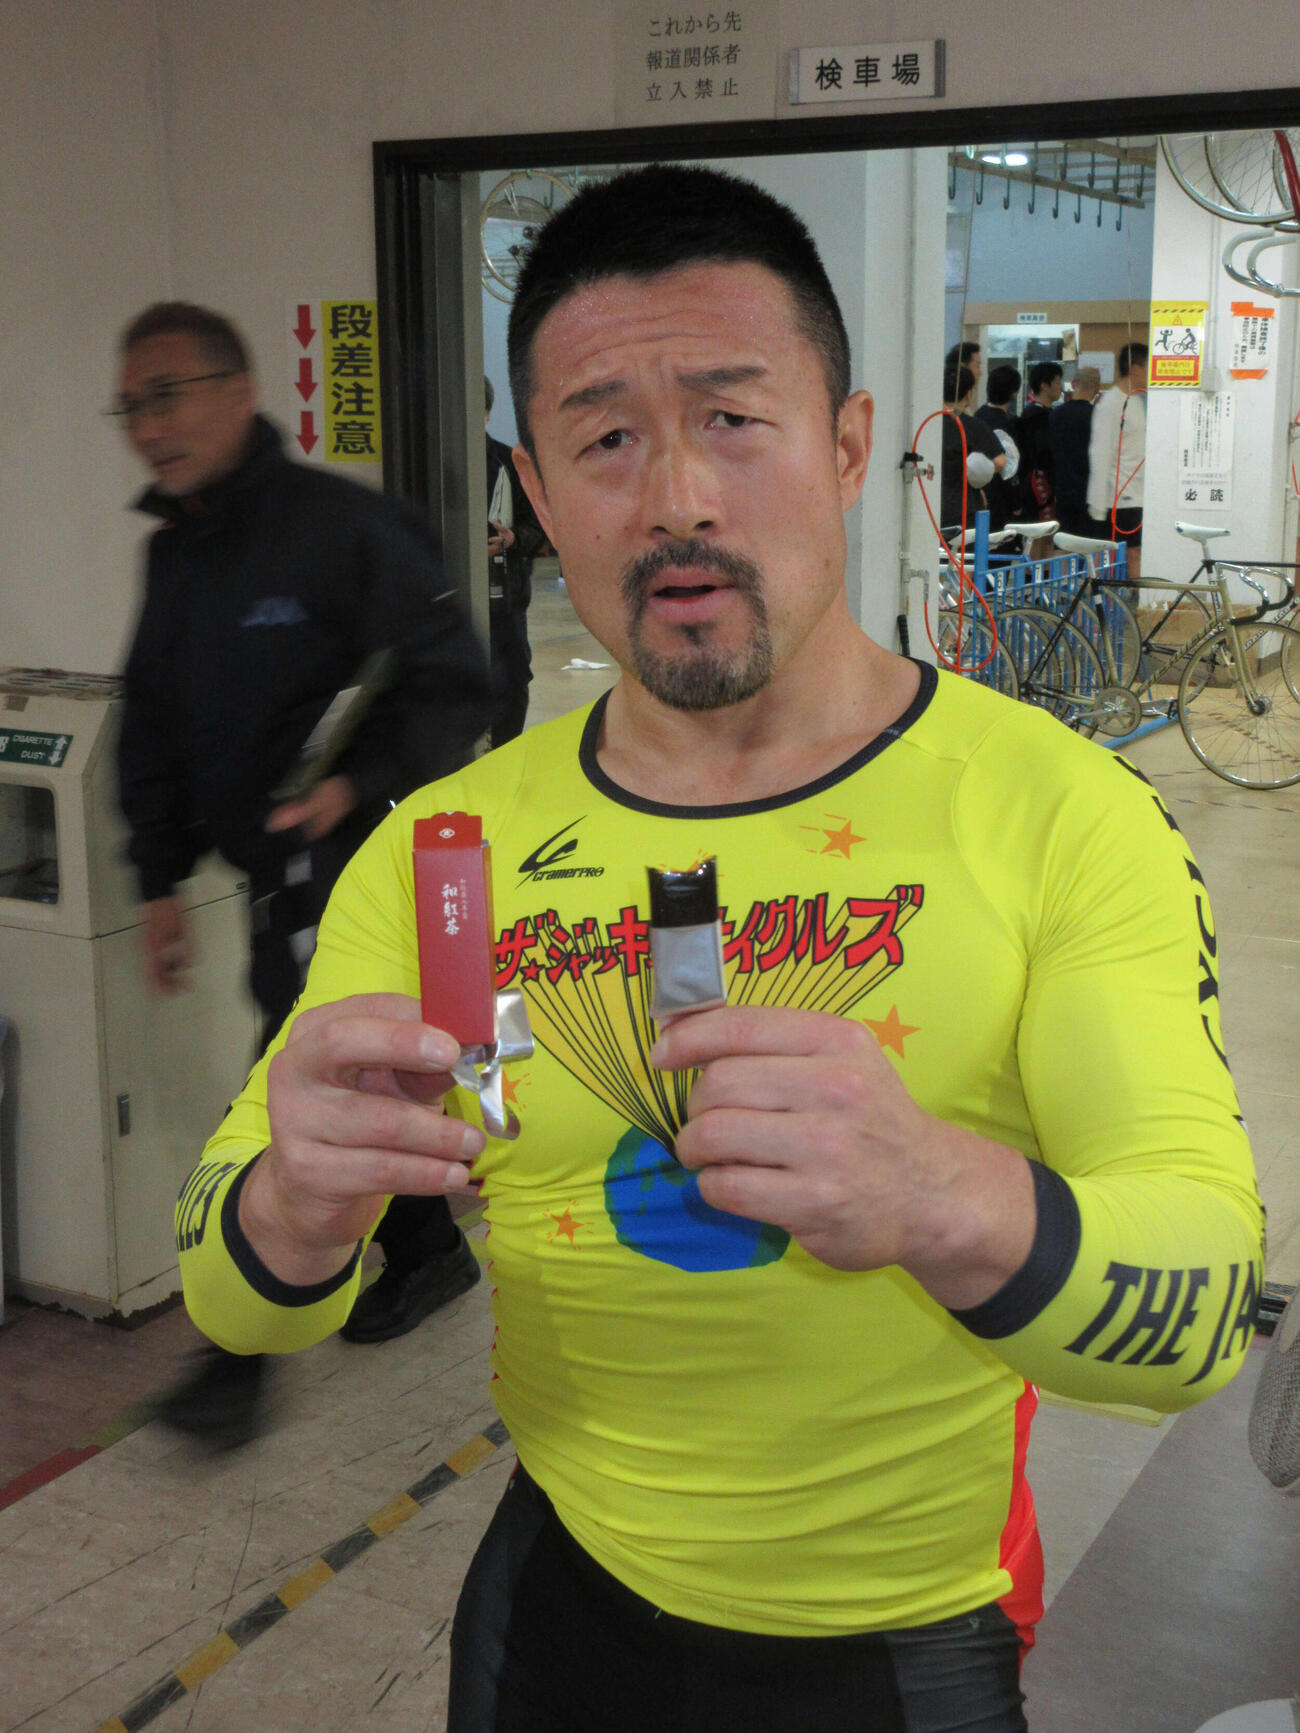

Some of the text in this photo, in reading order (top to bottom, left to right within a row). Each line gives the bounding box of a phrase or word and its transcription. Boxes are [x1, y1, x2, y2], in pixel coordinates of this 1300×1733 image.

[648, 11, 742, 37] これから先
[646, 44, 742, 71] 報道関係者
[815, 53, 921, 91] 検車場
[646, 77, 739, 101] 立入禁止
[329, 304, 375, 455] 段差注意
[12, 734, 54, 746] CIGARETTE
[20, 750, 46, 760] DUST
[441, 883, 460, 936] 和紅茶
[1063, 1260, 1263, 1387] THE JA
